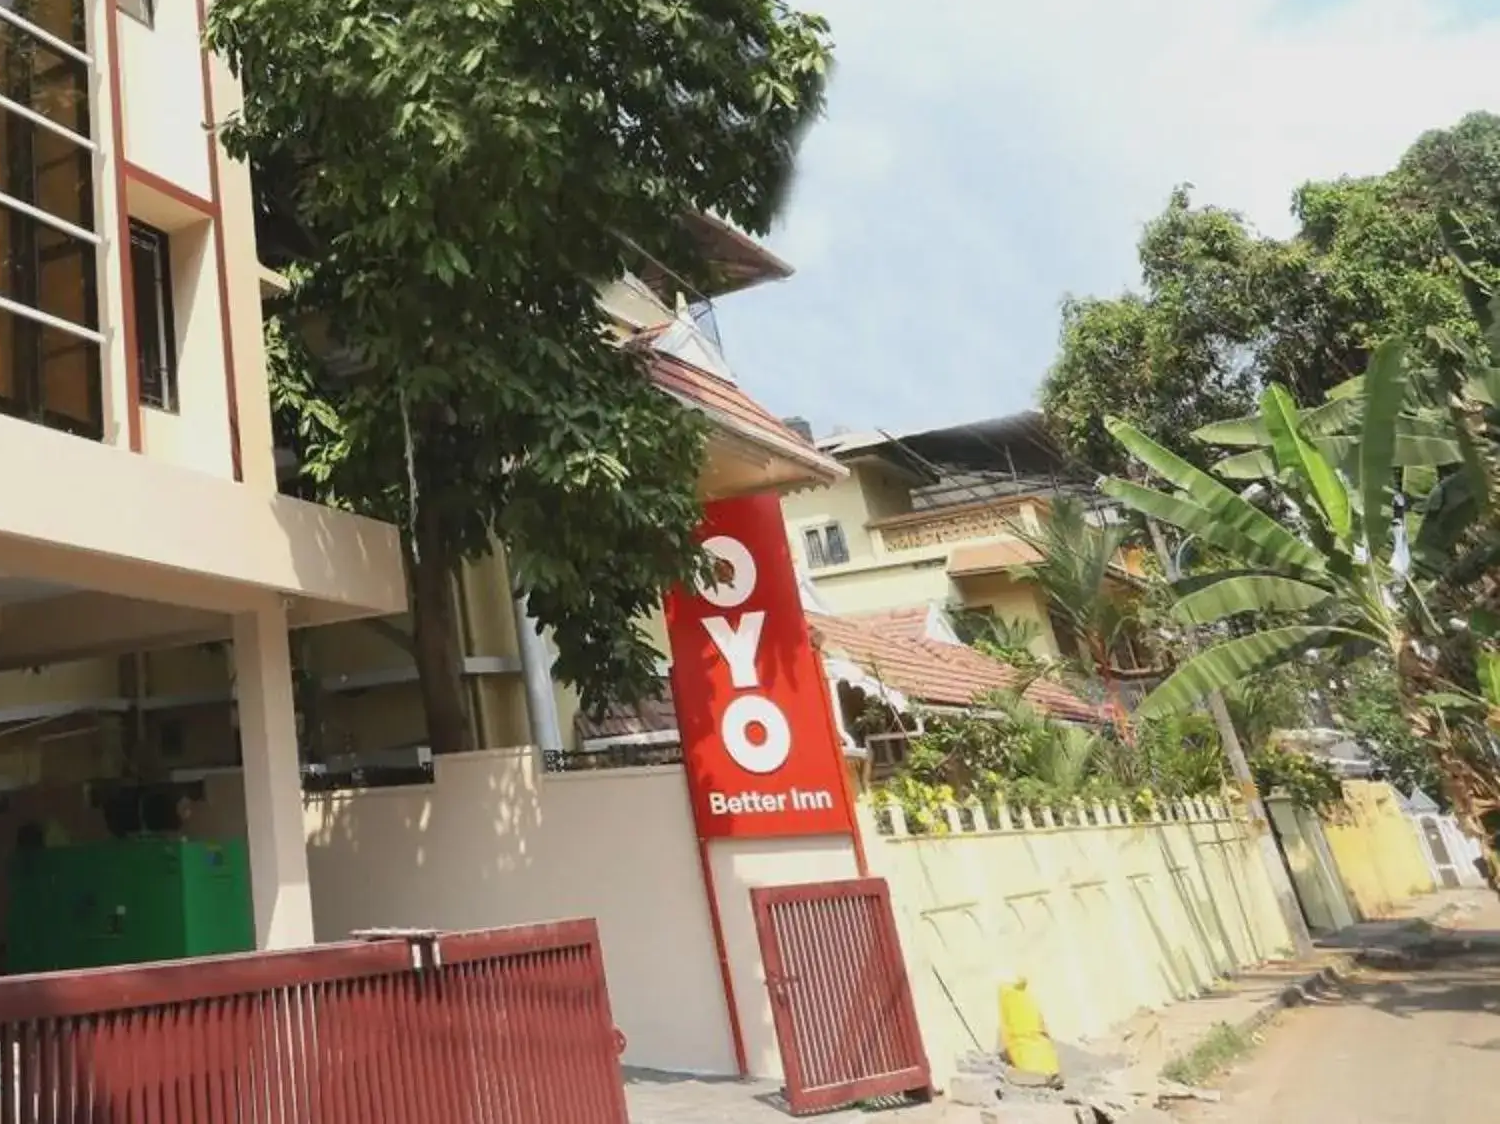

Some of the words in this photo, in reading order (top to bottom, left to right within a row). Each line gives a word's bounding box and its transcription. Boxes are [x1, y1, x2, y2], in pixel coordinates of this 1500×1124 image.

[696, 536, 791, 773] OYO
[709, 790, 786, 814] Better
[790, 787, 833, 810] Inn
